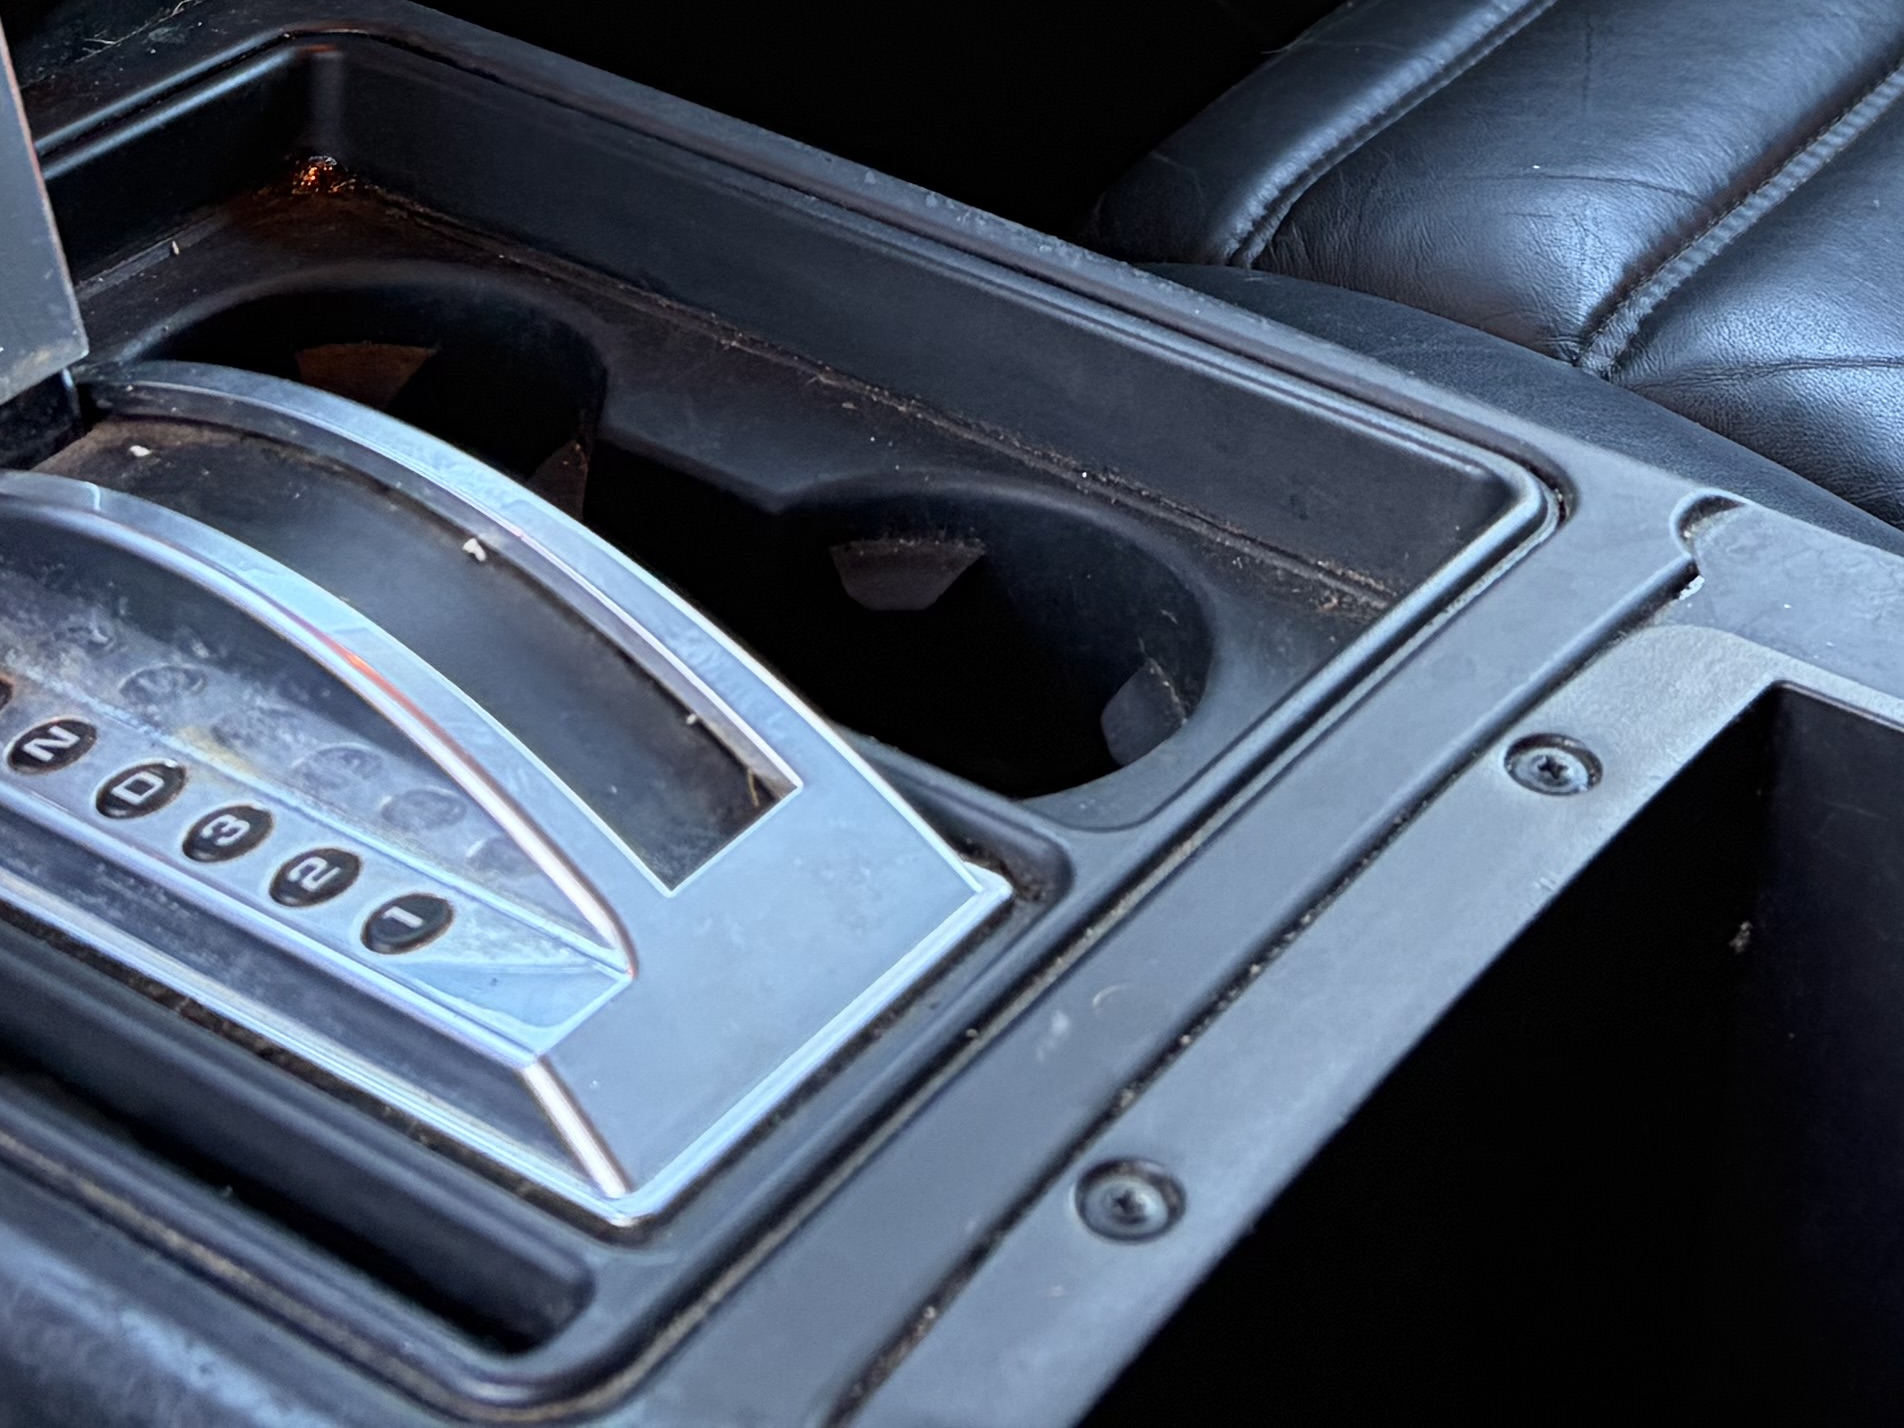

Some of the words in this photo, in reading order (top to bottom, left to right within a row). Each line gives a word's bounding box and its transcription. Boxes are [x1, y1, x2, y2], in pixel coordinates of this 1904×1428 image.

[22, 724, 80, 762] N
[111, 771, 165, 805] D
[199, 813, 251, 845] 3
[287, 855, 342, 892] 2
[382, 905, 424, 929] 1
